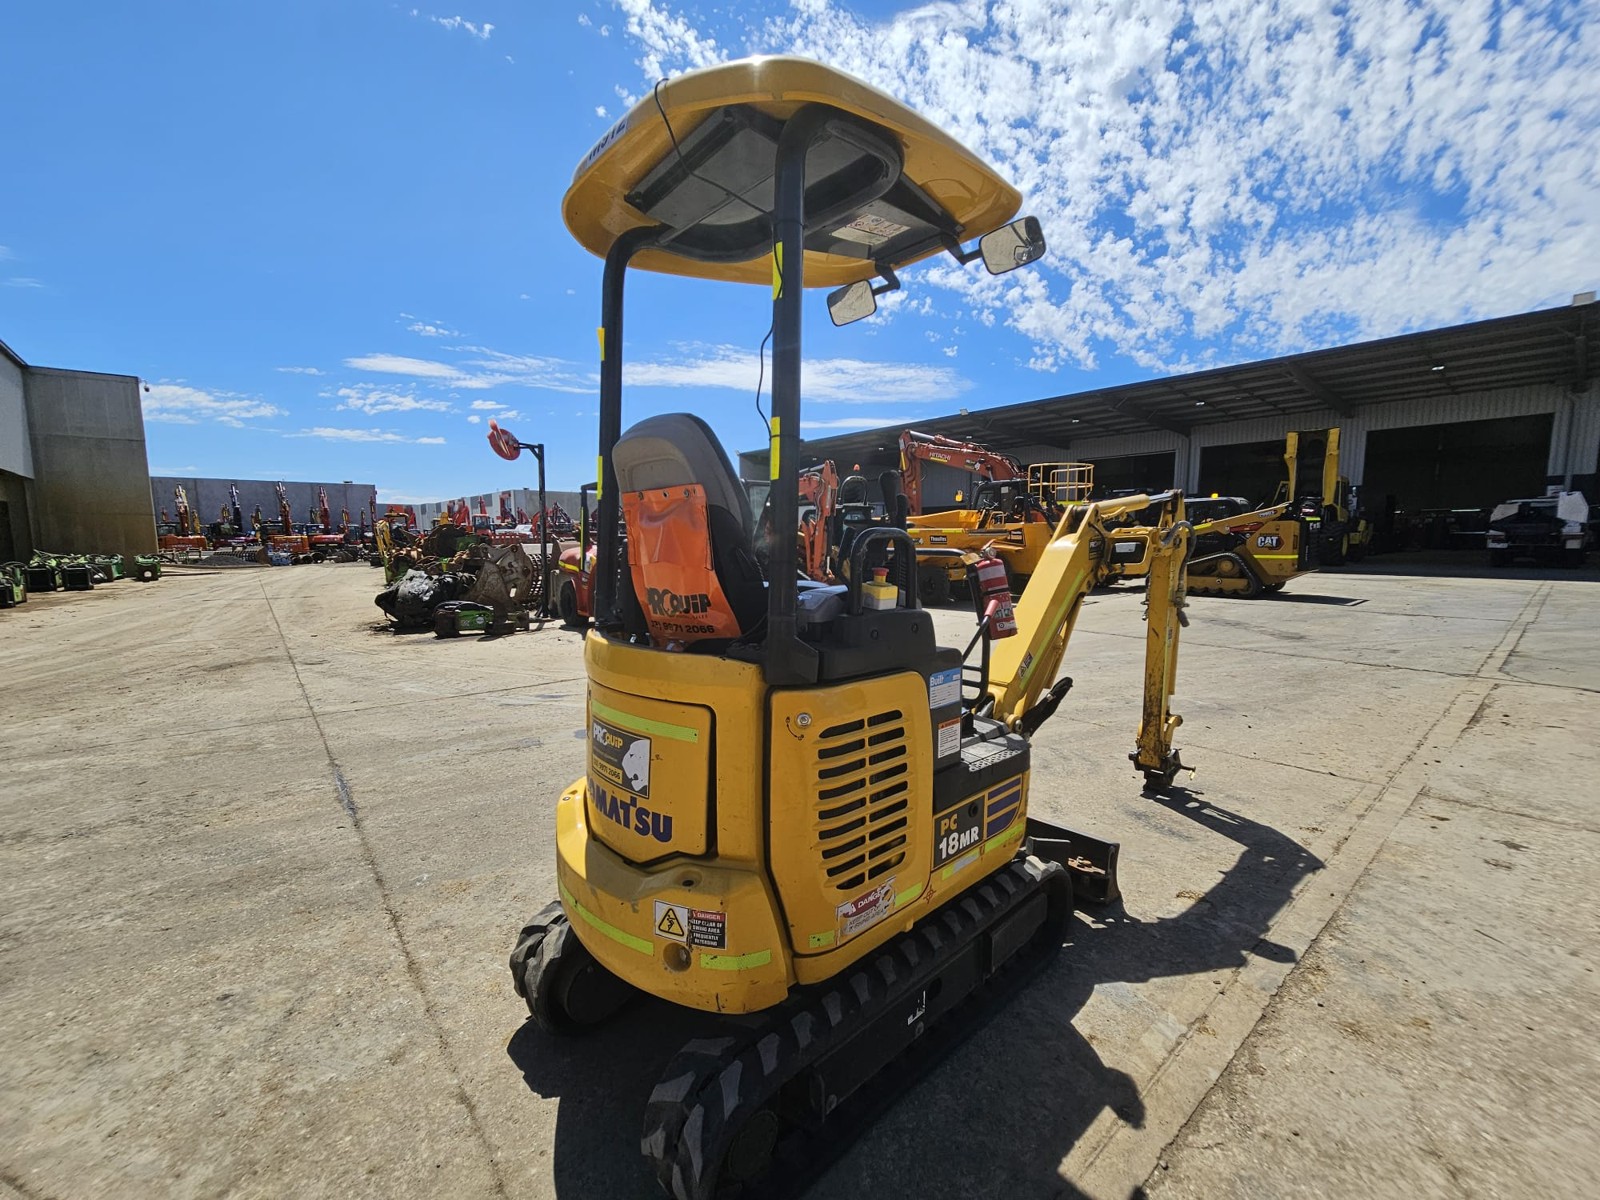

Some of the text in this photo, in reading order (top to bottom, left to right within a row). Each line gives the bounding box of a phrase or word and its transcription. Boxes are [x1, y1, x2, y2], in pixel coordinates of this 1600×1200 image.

[1257, 536, 1279, 548] CAT
[685, 624, 715, 634] 2066
[940, 813, 958, 836] PC
[939, 826, 979, 860] 18MR
[697, 912, 721, 920] DANGER
